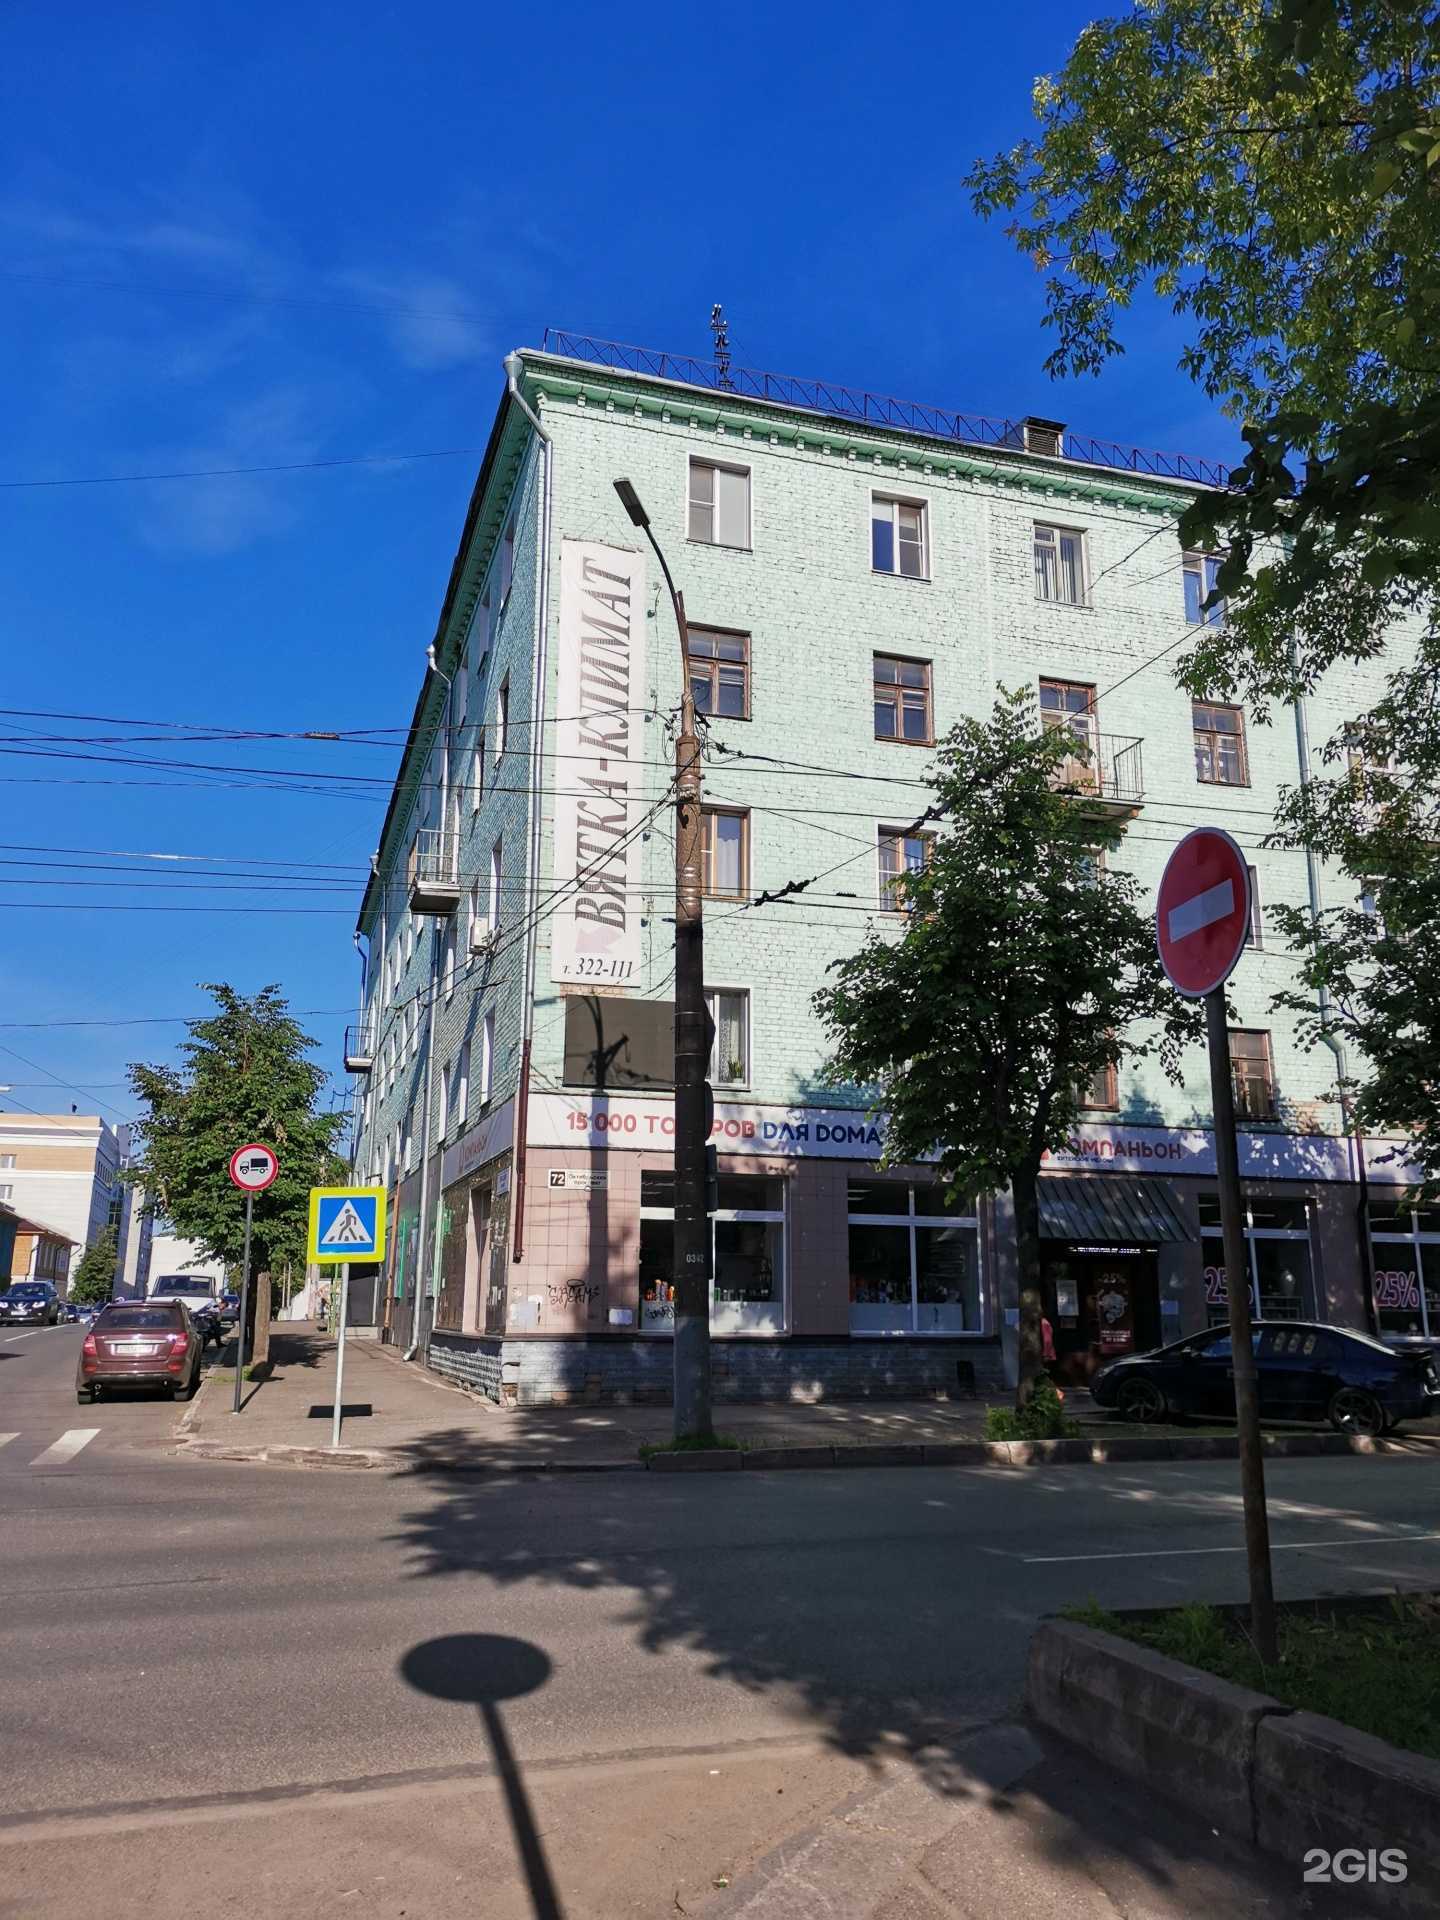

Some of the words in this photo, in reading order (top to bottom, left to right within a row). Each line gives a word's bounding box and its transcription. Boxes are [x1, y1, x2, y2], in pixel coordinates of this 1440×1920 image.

[575, 557, 631, 932] ВЯТКА-КЛИМАТ
[576, 957, 632, 977] 322-111
[644, 1115, 755, 1139] ТОРОВ
[1059, 1137, 1181, 1160] ОМПАНЬОН
[551, 1173, 565, 1184] 72
